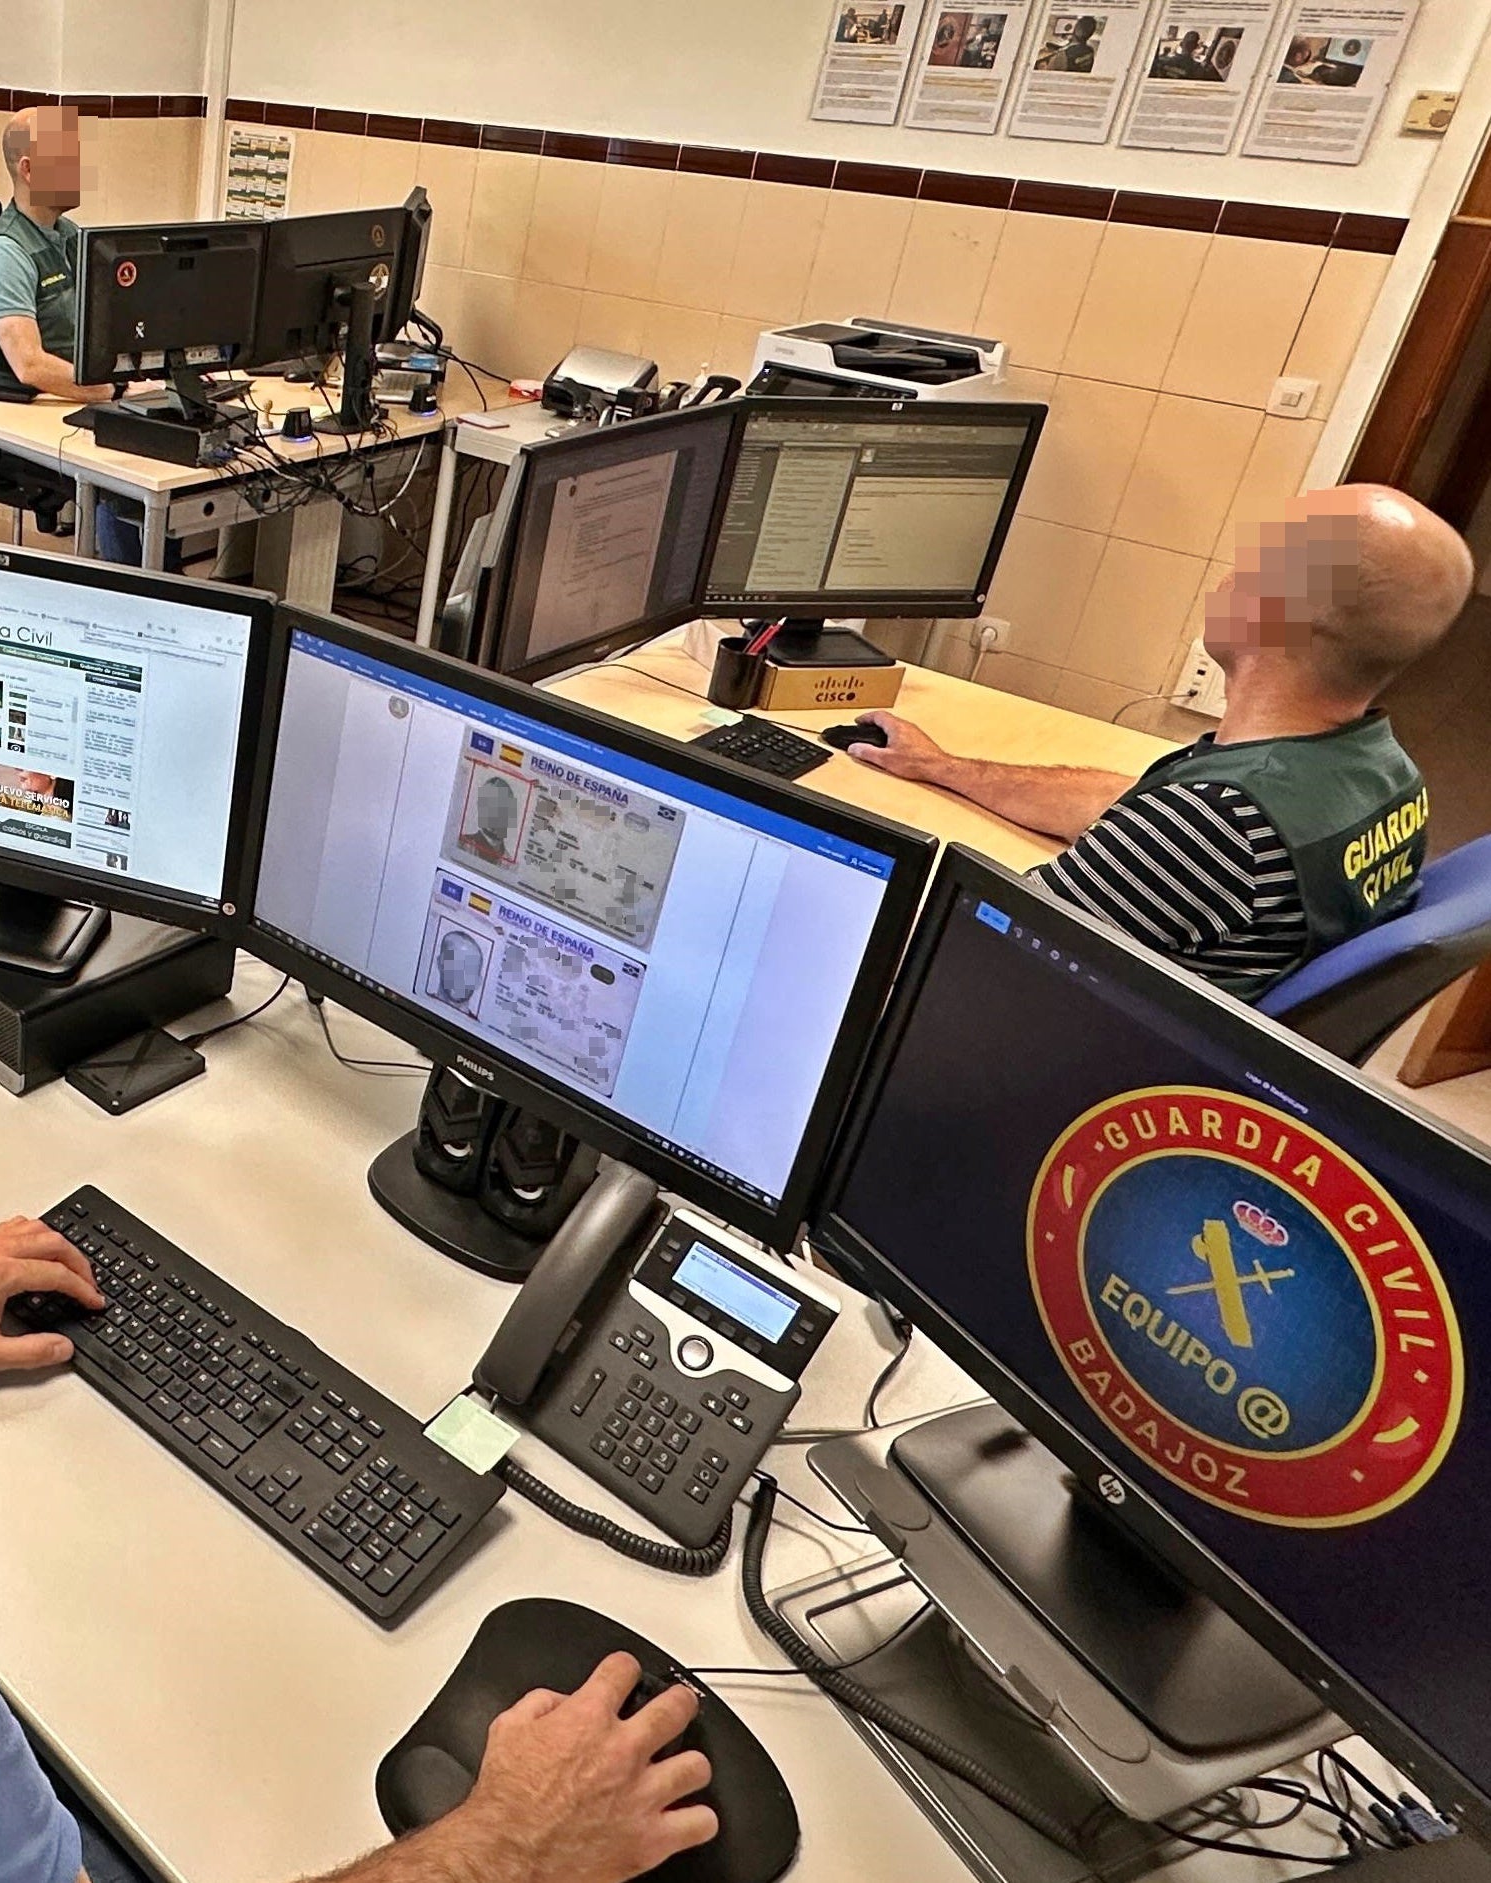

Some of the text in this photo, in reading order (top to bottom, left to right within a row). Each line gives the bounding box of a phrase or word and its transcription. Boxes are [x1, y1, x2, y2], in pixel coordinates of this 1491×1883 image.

[17, 626, 53, 647] Civil
[24, 790, 70, 809] SERVICIO
[531, 756, 629, 805] REINO DE ESPAÑA
[1362, 847, 1413, 909] CIVIL
[499, 905, 595, 958] REINO DE ESPAÑA
[456, 1054, 495, 1081] PHILIPS
[1103, 1106, 1435, 1353] GUARDIA CIVIL
[1100, 1273, 1290, 1438] EQUIPO @
[1068, 1337, 1250, 1498] BADAJOZ
[1099, 1474, 1126, 1504] hp
